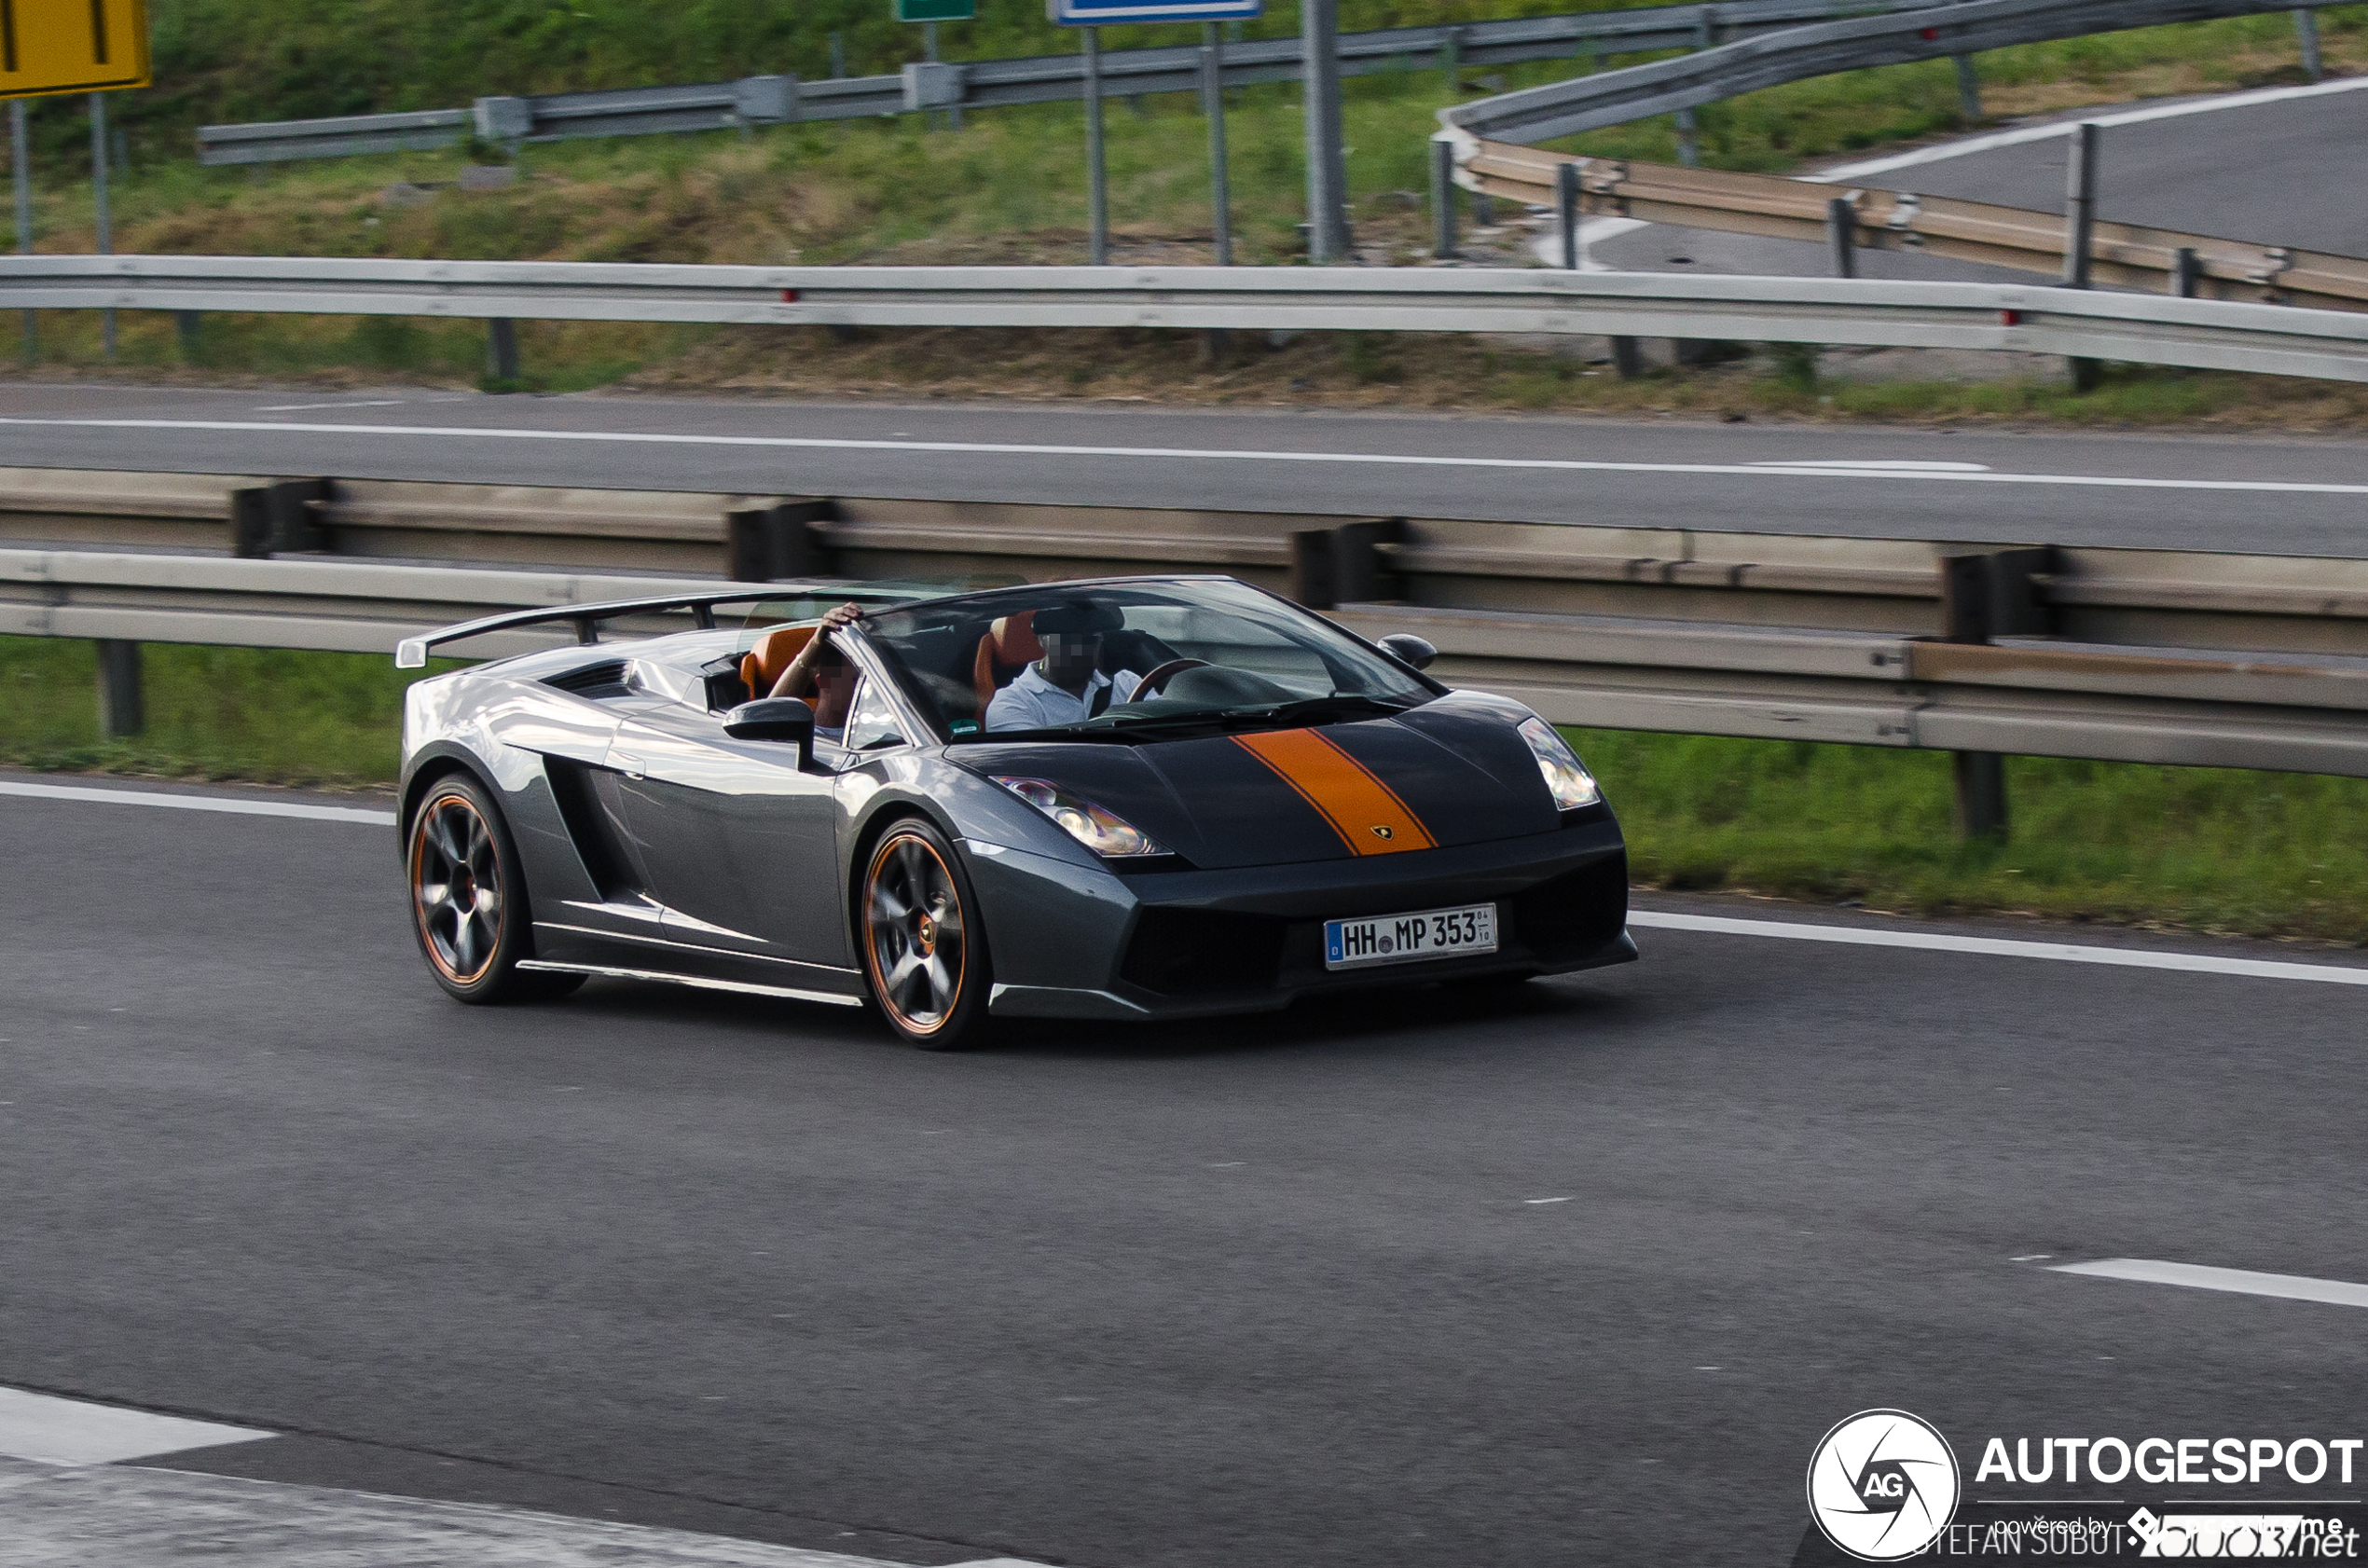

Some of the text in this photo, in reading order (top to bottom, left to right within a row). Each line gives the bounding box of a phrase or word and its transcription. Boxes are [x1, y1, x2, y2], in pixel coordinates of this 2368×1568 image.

[1344, 912, 1477, 956] HH MP 353
